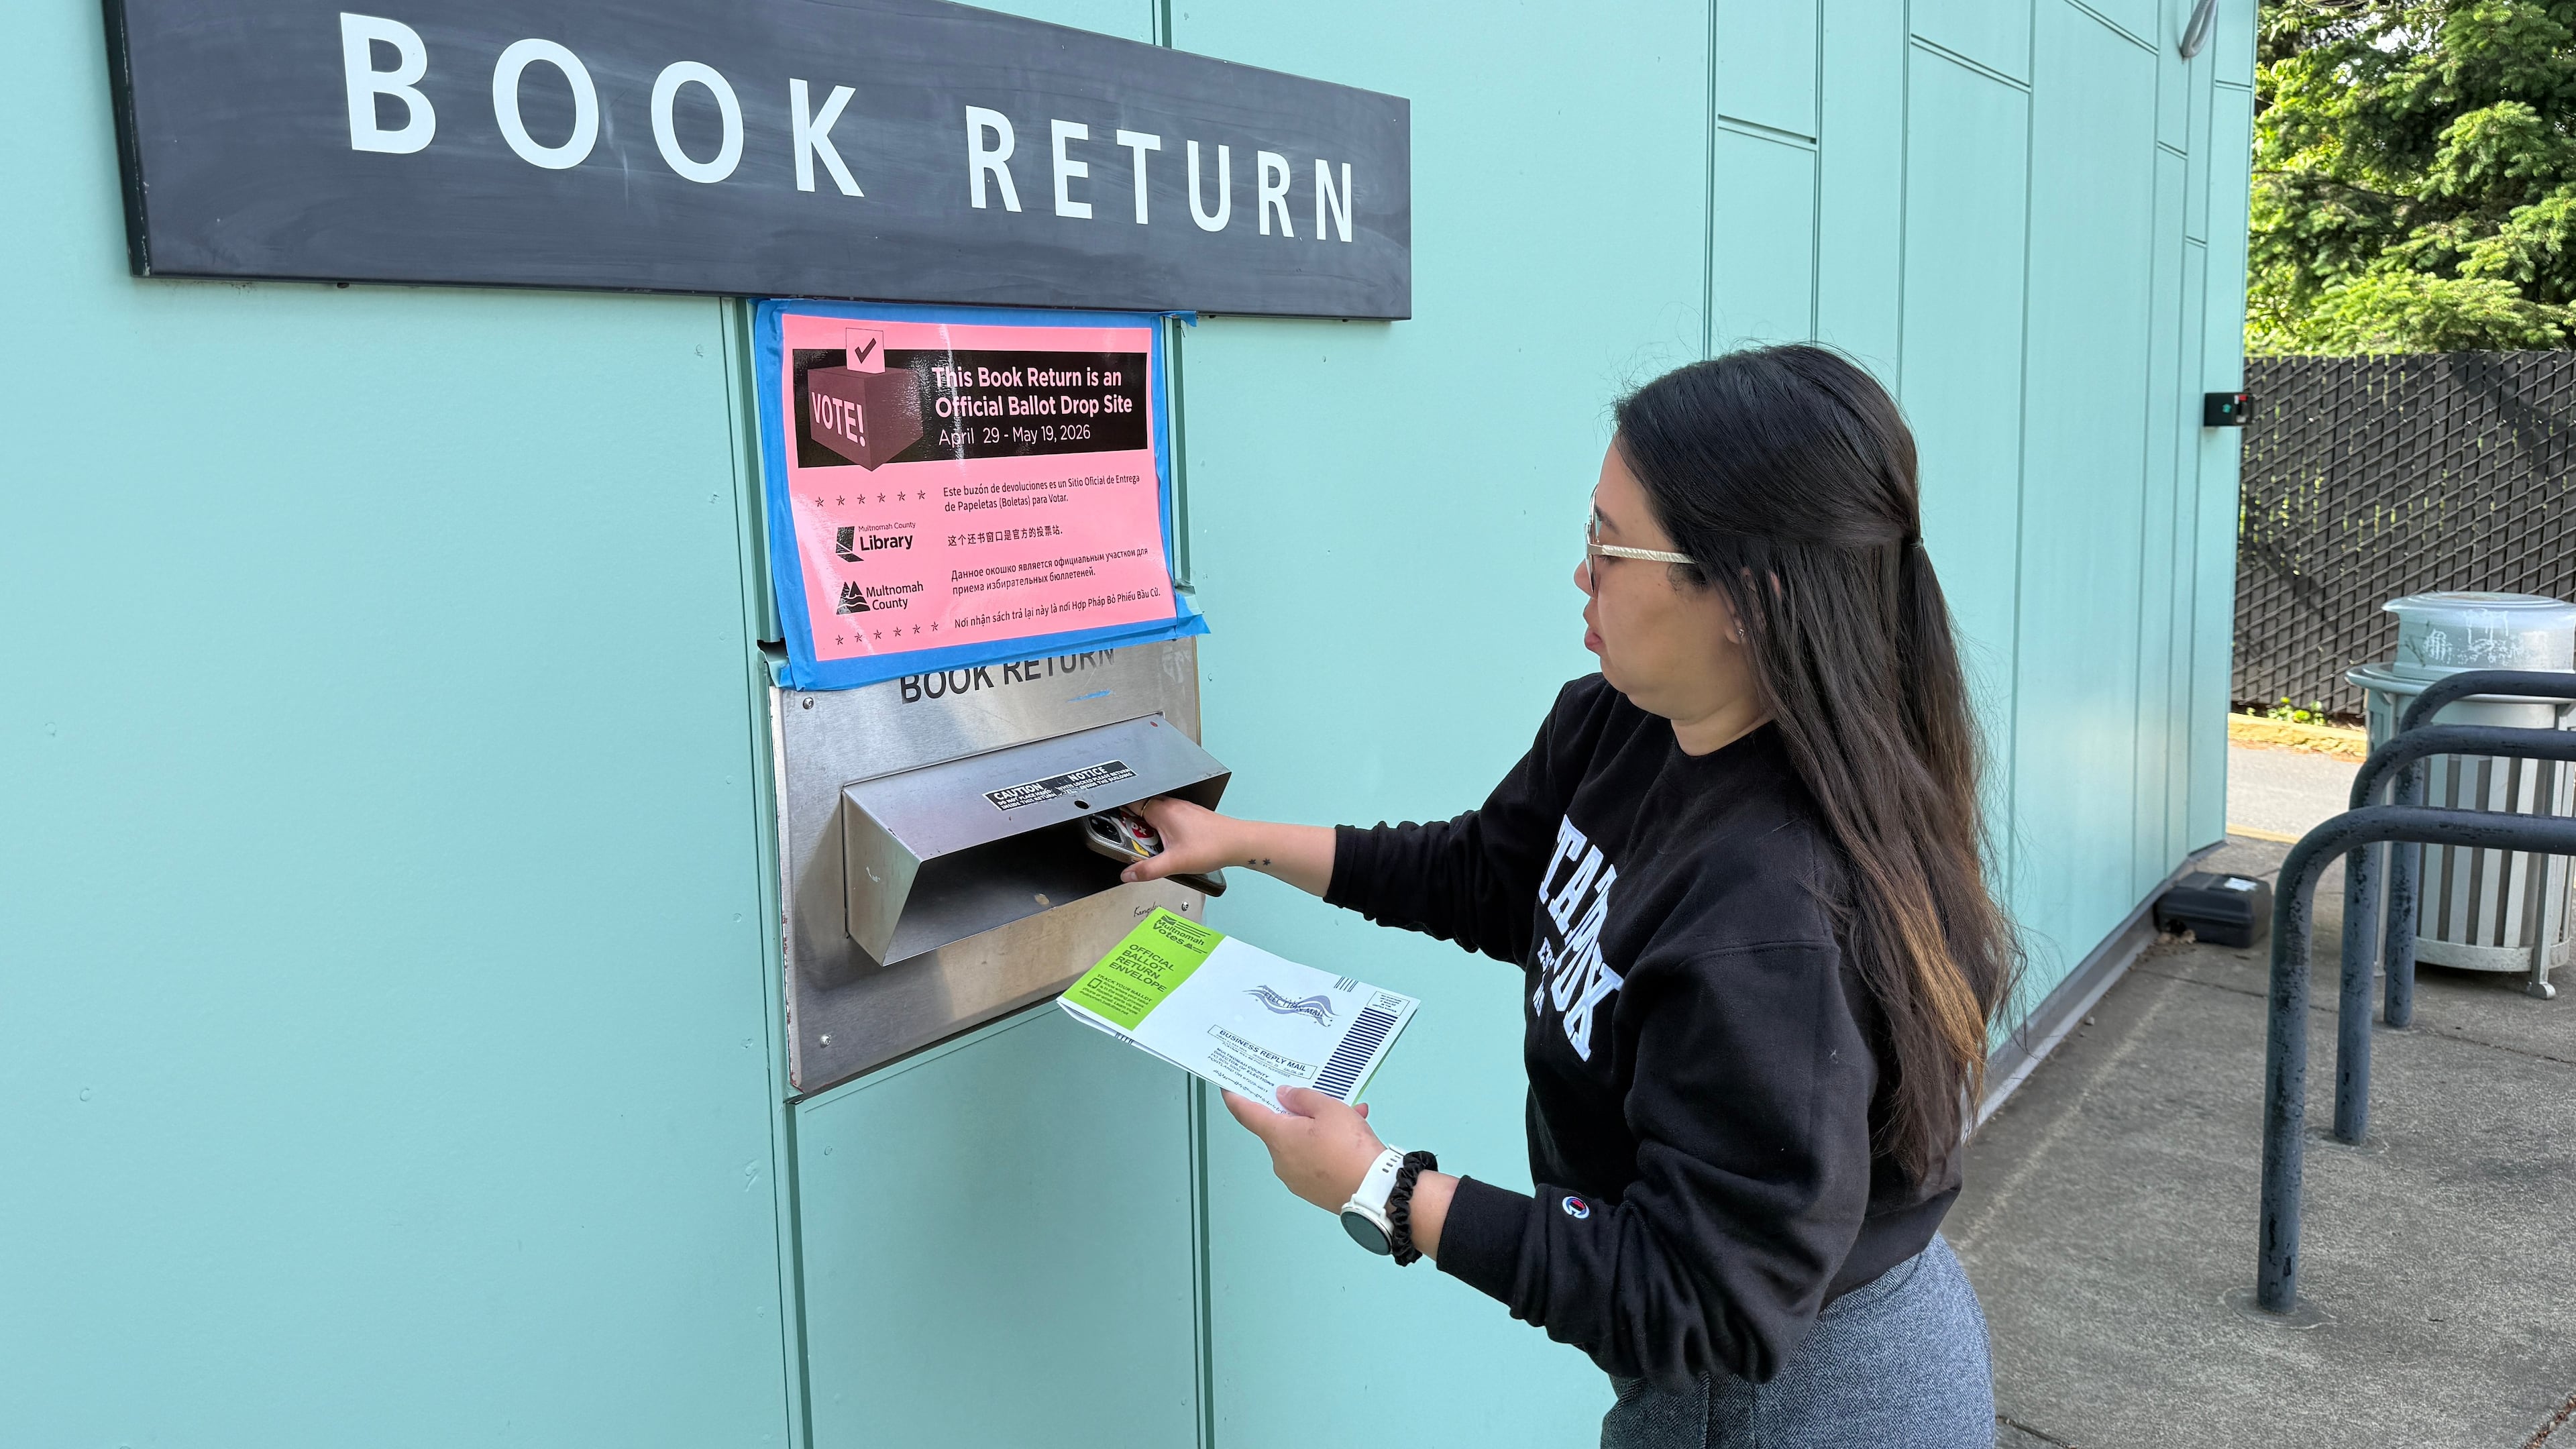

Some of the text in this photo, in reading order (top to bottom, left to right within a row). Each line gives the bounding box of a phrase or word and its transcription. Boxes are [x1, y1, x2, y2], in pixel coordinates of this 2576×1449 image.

[339, 13, 1352, 242] BOOK RETURN
[932, 367, 1122, 387] This Book Return is an
[935, 394, 1132, 417] Official Ballot Drop Site
[812, 392, 865, 447] VOTE!
[939, 429, 974, 447] April
[983, 427, 1000, 443] 29
[1013, 427, 1038, 445] May
[1041, 425, 1057, 443] 19,
[1060, 425, 1091, 440] 2026
[943, 487, 961, 496] Este
[963, 484, 989, 495] buzón
[991, 483, 1000, 493] de
[1002, 481, 1048, 492] devoluciones
[1068, 478, 1083, 487] Sitio
[1085, 476, 1106, 486] Oficial
[1106, 476, 1114, 484] de
[1116, 475, 1140, 484] Entrega
[945, 494, 1068, 512] de Papeletas (Boletas) para Votar.
[859, 521, 916, 532] Multnomah County
[860, 535, 913, 551] Library
[951, 548, 1148, 582] Данное окошко является официальным участком для
[866, 581, 923, 598] Multnomah
[953, 566, 1095, 596] приема избирательных бюллетеней.
[872, 598, 908, 610] County
[955, 617, 968, 629] Nơi
[971, 614, 990, 626] nhận
[993, 611, 1010, 623] sách
[1012, 608, 1022, 619] trả
[1024, 607, 1034, 619] lại
[1036, 604, 1049, 616] này
[1051, 603, 1057, 614] là
[1059, 601, 1070, 612] nơi
[1072, 600, 1086, 611] Hợp
[1088, 596, 1106, 607] Pháp
[900, 665, 994, 704] BOOK
[1067, 767, 1108, 782] NOTICE
[1091, 773, 1111, 782] PLEASE
[1110, 767, 1130, 776] RETURN
[994, 783, 1044, 800] CAUTION
[1034, 792, 1057, 802] RETURN
[1152, 923, 1184, 945] Votes
[1156, 920, 1204, 946] Multnomah
[1116, 956, 1160, 979] RETURN
[1122, 951, 1166, 972] BALLOT
[1129, 944, 1175, 971] OFFICIAL
[1097, 974, 1152, 1002] TRACK YOUR BALLOT
[1109, 963, 1167, 993] ENVELOPE
[1220, 1030, 1259, 1053] BUSINESS
[1260, 1051, 1287, 1064] REPLY
[1287, 1061, 1305, 1071] MAIL
